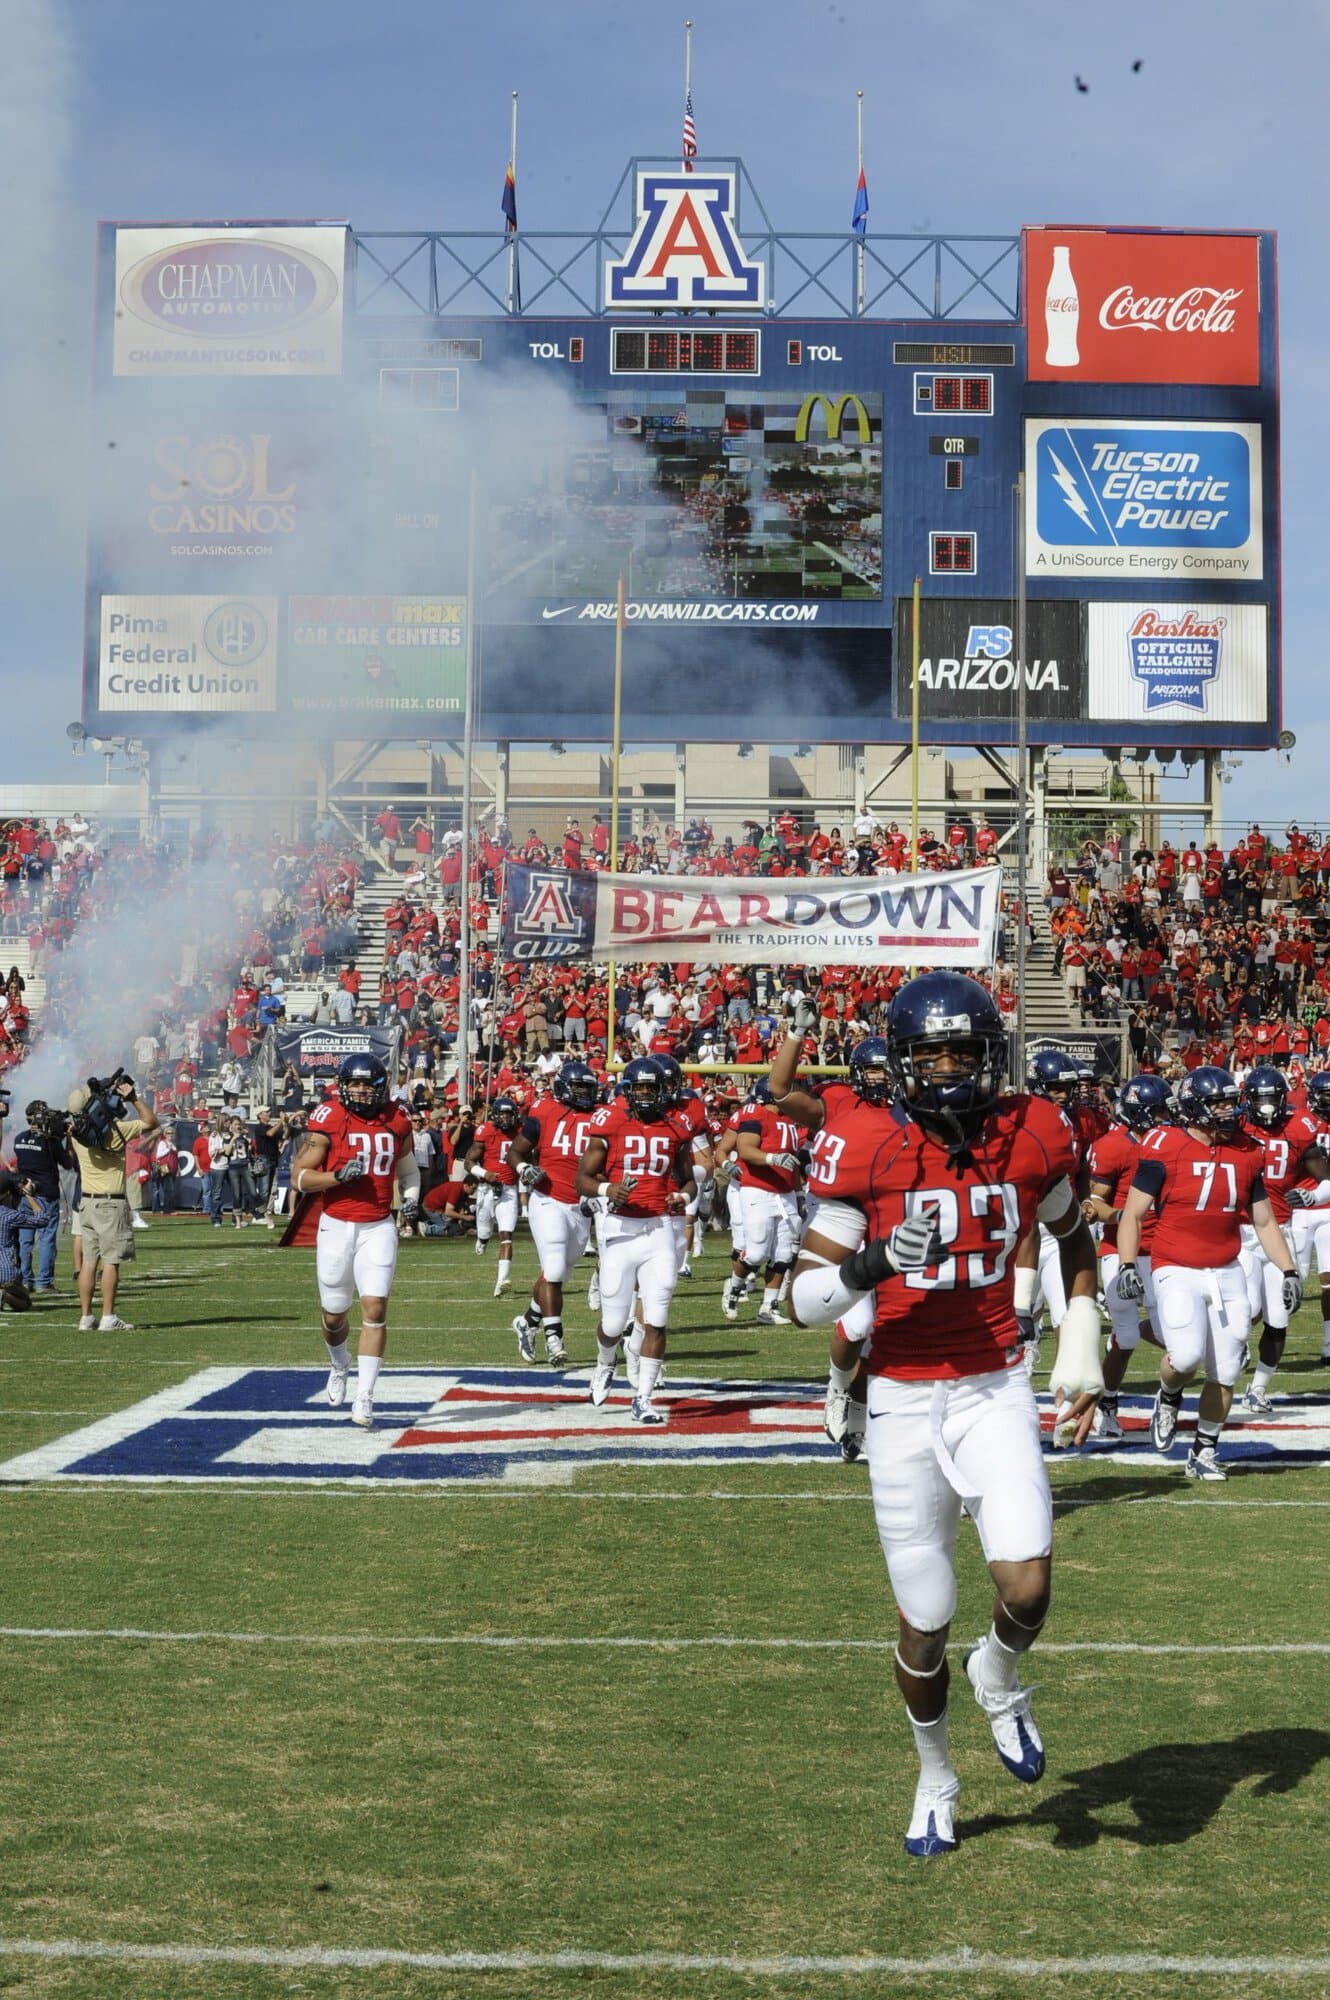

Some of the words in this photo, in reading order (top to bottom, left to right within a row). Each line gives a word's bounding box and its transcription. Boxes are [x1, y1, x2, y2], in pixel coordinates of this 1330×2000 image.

[158, 263, 299, 300] CHAPMAN
[1098, 285, 1244, 333] Coca-Cola
[529, 343, 564, 358] TOL
[807, 346, 842, 361] TOL
[933, 346, 972, 364] WSU
[943, 438, 965, 454] QTR
[148, 432, 297, 503] SOL
[1091, 442, 1200, 473] Tucson
[1102, 472, 1230, 502] Electric
[147, 503, 297, 535] CASINOS
[1115, 501, 1229, 531] Power
[170, 545, 273, 556] SOLCASINOS.COM
[1036, 553, 1047, 565] A
[1051, 553, 1125, 567] UniSource
[1129, 554, 1178, 570] Energy
[1182, 555, 1250, 572] Company
[577, 603, 819, 621] ARIZONAWILDCATS.COM
[110, 614, 168, 633] Pima
[1131, 611, 1224, 637] Bashas'
[335, 627, 380, 646] CARE
[385, 627, 461, 646] CENTERS
[964, 625, 1013, 659] FS
[109, 642, 197, 664] Federal
[1137, 642, 1213, 655] OFFICIAL
[1137, 655, 1213, 667] TAILGATE
[1137, 667, 1212, 676] HEADQUARTERS
[108, 673, 181, 694] Credit
[187, 673, 259, 694] Union
[908, 658, 1060, 691] ARIZONA
[1150, 684, 1201, 695] ARIZONA
[512, 939, 581, 958] CLUB
[716, 933, 743, 945] THE
[748, 933, 828, 946] TRADITION
[834, 935, 873, 947] LIVES
[301, 1053, 340, 1068] Family
[551, 1120, 591, 1156] 46
[776, 1121, 799, 1150] 70
[1142, 1128, 1168, 1150] 71
[348, 1132, 394, 1176] 38
[623, 1135, 670, 1176] 26
[1191, 1161, 1238, 1213] 71
